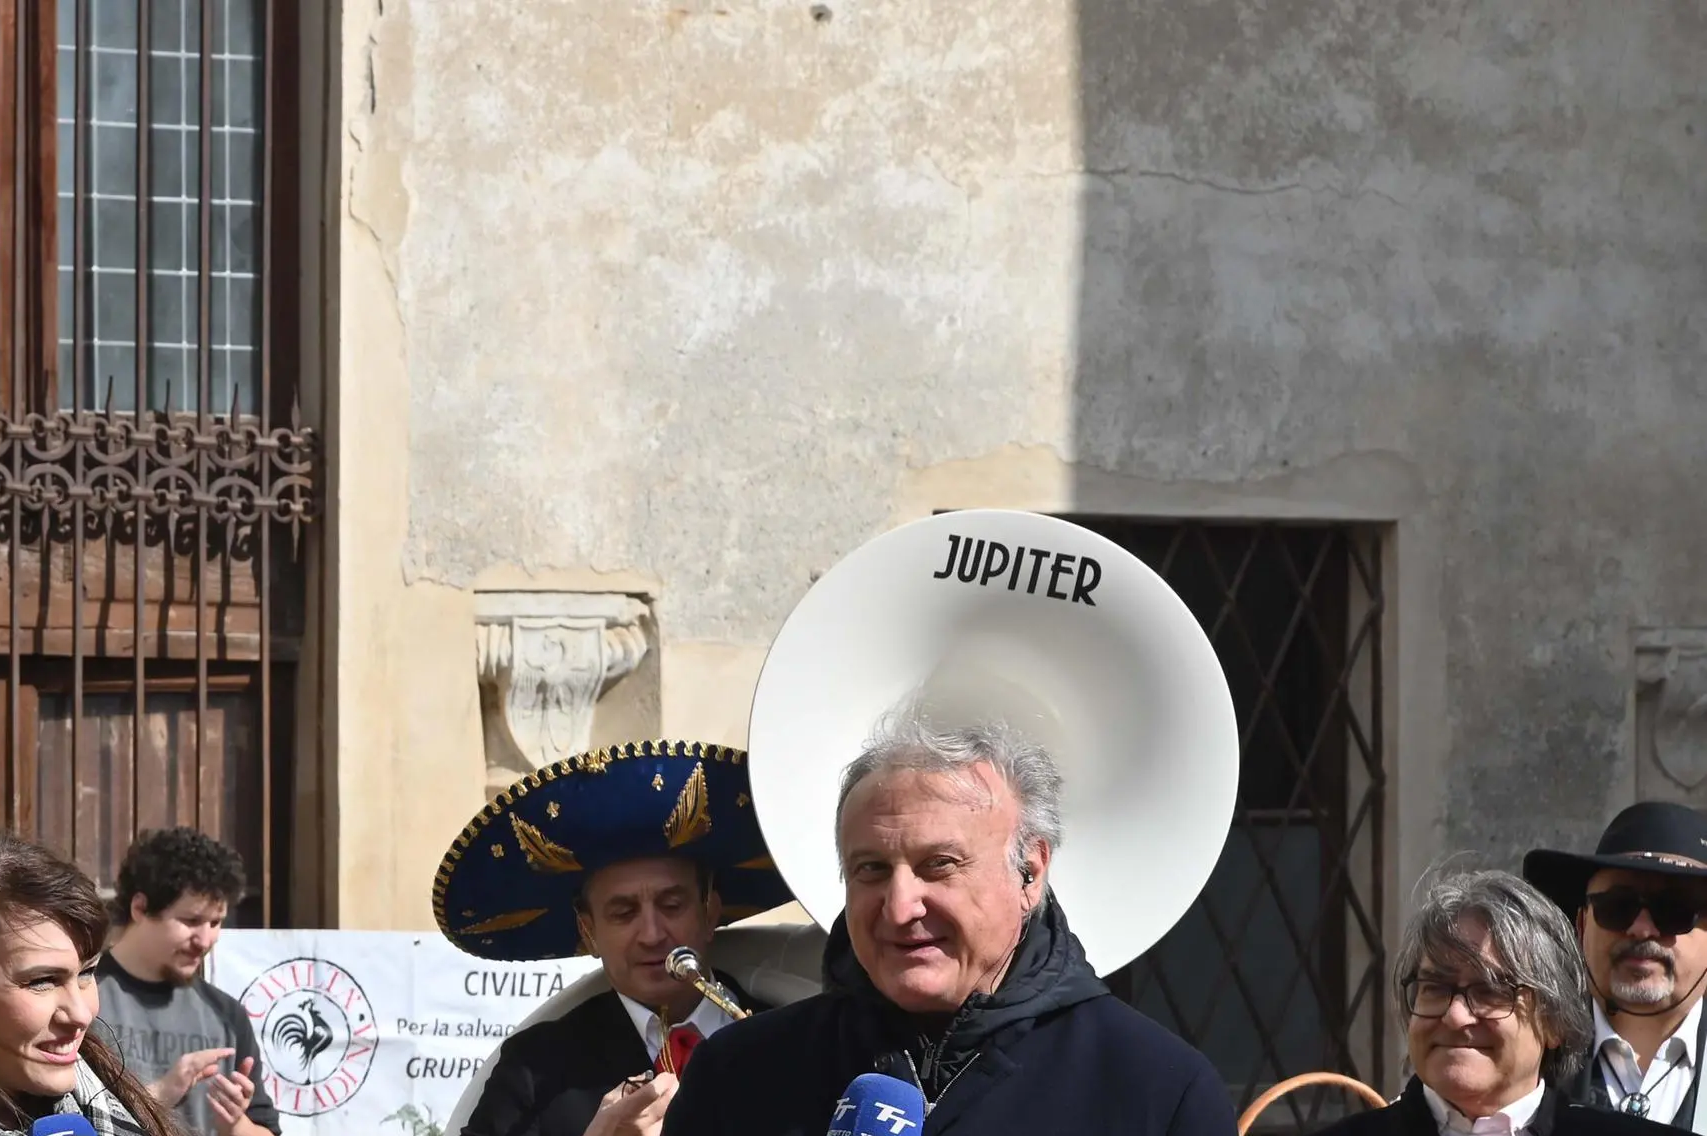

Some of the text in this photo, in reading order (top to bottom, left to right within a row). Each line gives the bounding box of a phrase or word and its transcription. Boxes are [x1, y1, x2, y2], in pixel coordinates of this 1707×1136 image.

[933, 533, 1102, 607] JUPITER
[464, 963, 564, 997] CIVILTÀ
[396, 1018, 428, 1036] Per
[432, 1018, 449, 1037] la
[874, 1101, 917, 1135] TT
